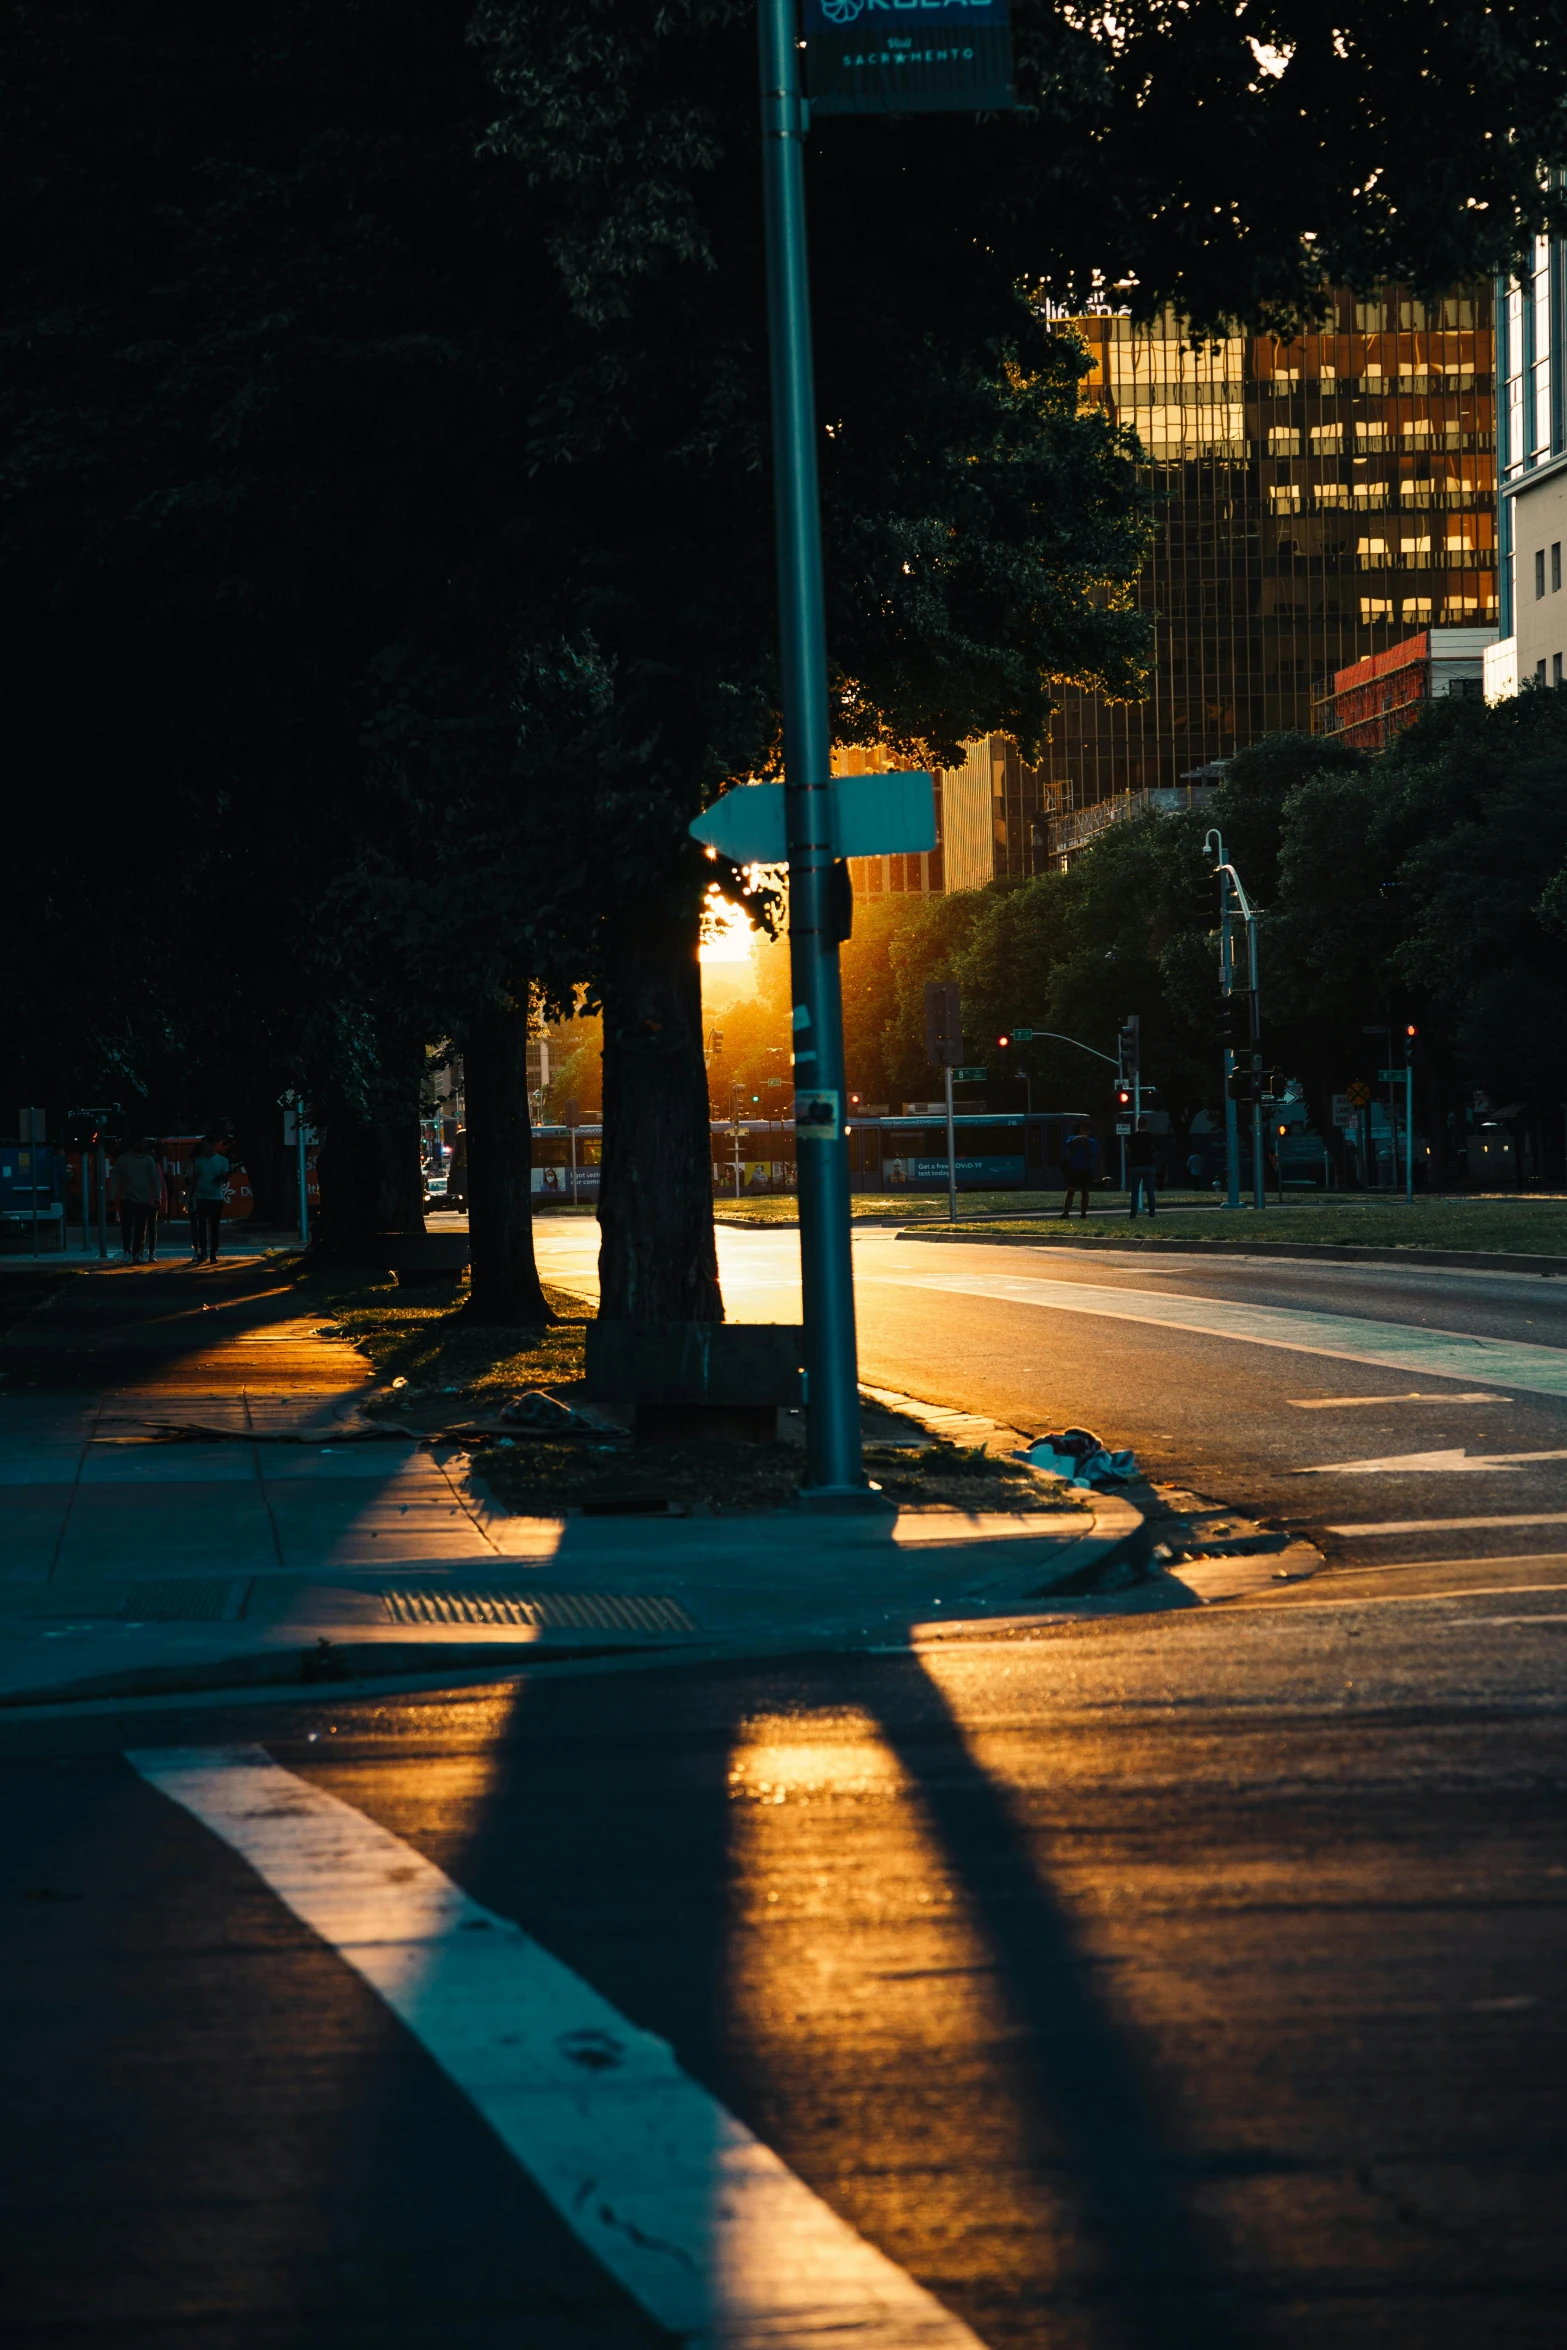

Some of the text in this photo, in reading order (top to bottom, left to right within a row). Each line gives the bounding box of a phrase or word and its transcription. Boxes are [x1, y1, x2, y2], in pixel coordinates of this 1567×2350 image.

[955, 1162, 983, 1170] OVID-19
[918, 1169, 950, 1178] test today
